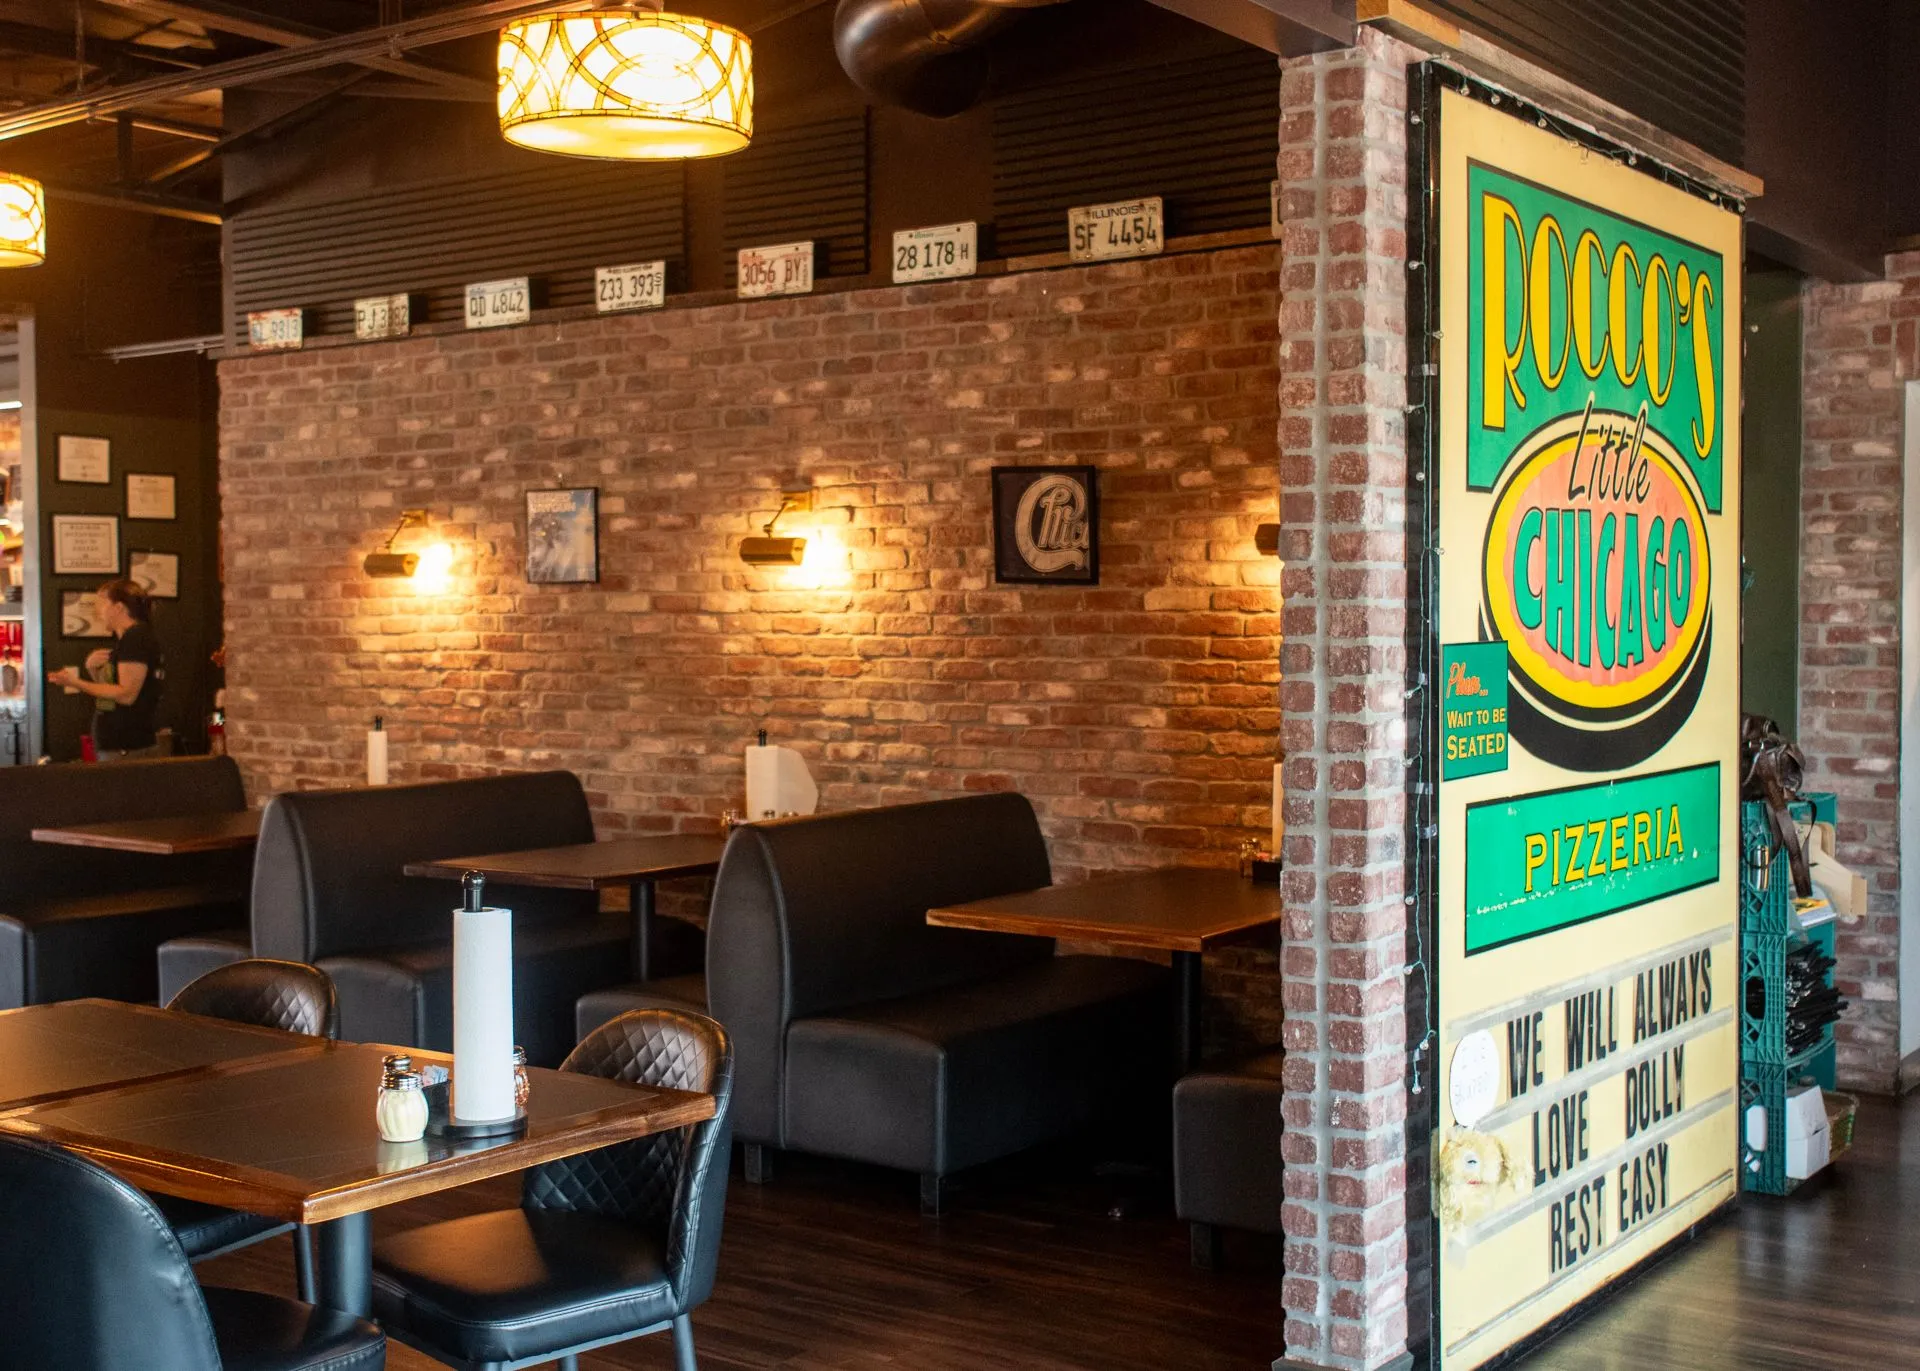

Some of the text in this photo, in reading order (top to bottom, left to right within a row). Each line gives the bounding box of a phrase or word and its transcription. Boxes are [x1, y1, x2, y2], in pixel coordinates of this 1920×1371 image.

[896, 241, 969, 271] 28 178 H
[1074, 216, 1157, 251] SF 4454
[1091, 205, 1139, 219] ILLINOIS
[492, 291, 524, 315] 4842
[599, 277, 623, 302] 233
[630, 273, 654, 298] 393
[741, 259, 776, 287] 3056
[785, 257, 802, 283] BY
[1483, 193, 1716, 457] ROCCO'S
[1567, 391, 1652, 506] Little
[1512, 507, 1692, 671] CHICAGO
[1524, 804, 1685, 893] PIZZERIA
[1507, 1012, 1544, 1098] WE
[1565, 986, 1617, 1072] WILL
[1634, 948, 1712, 1045] ALWAYS
[1534, 1043, 1685, 1188] LOVE DOLLY
[1550, 1142, 1670, 1274] REST EASY
